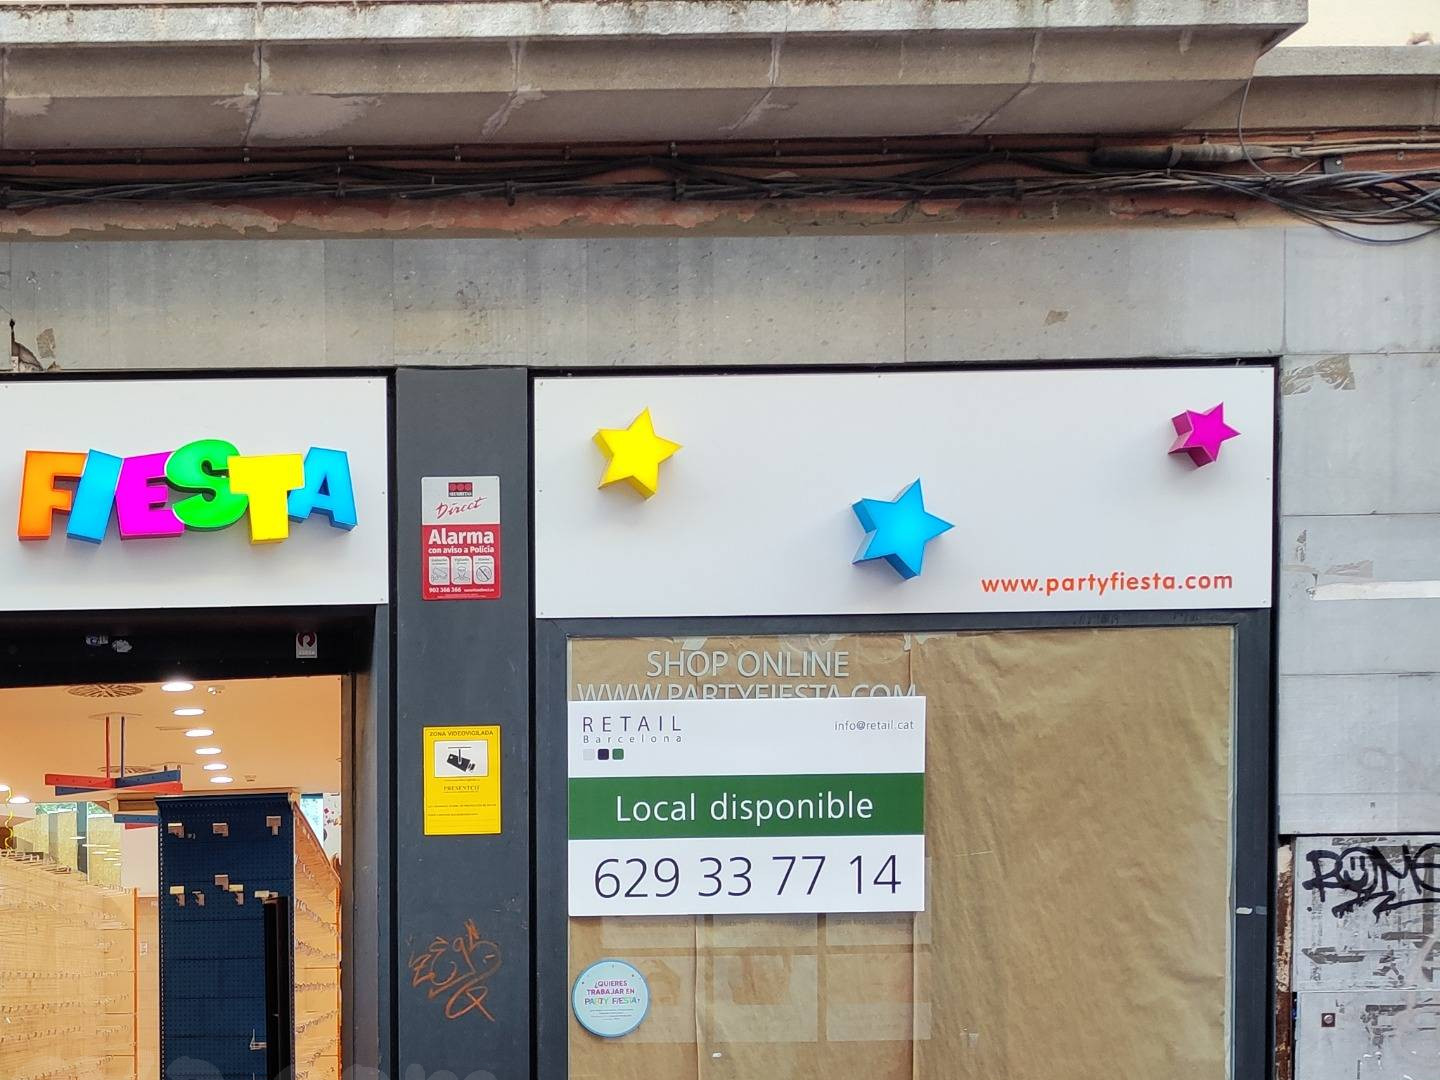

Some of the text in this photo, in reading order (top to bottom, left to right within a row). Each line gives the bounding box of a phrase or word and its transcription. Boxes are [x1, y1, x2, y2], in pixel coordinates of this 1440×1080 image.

[18, 439, 358, 545] FIESTA
[428, 528, 494, 545] Alarma
[443, 546, 462, 554] aviso
[981, 572, 1233, 596] www.partyfiesta.com
[646, 651, 849, 677] SHOP ONLINE
[582, 716, 682, 733] RETAIL
[834, 720, 914, 731] info@retail.cat
[583, 735, 682, 744] Barcelona
[616, 791, 873, 826] Local disponible
[594, 854, 902, 898] 629 33 77 14
[626, 987, 635, 995] EN
